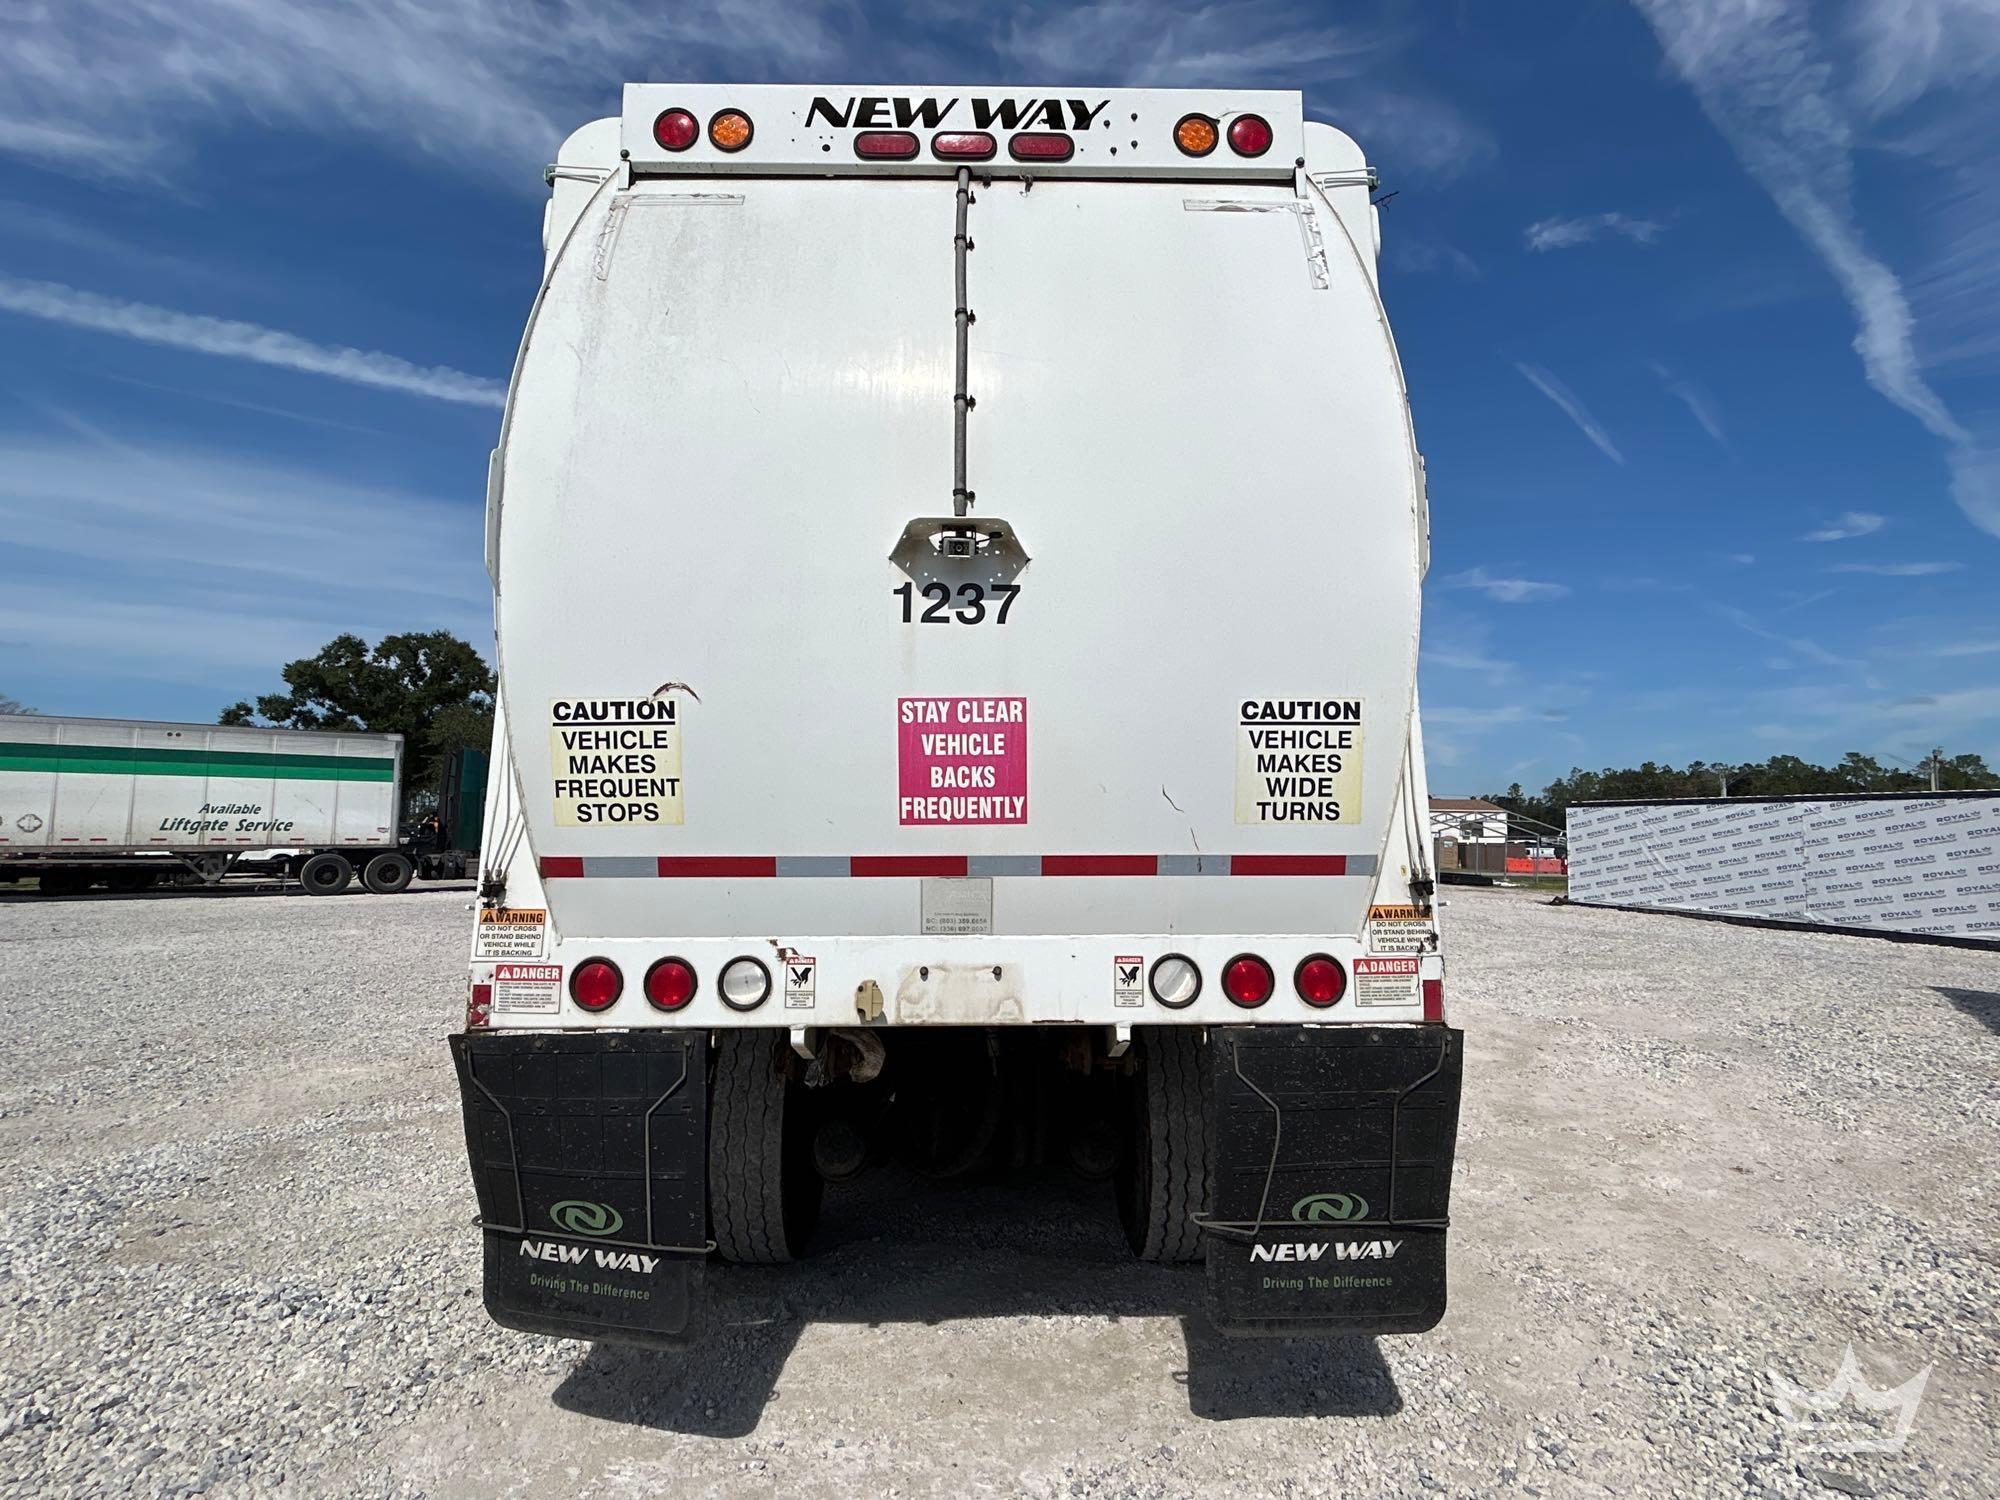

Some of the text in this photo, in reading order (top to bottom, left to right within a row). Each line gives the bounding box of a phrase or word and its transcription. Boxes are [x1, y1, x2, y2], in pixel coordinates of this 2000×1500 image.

[805, 97, 1110, 131] NEW WAY
[893, 582, 1021, 625] 1237
[552, 701, 676, 721] CAUTION
[901, 700, 1023, 723] STAY CLEAR
[1241, 701, 1361, 720] CAUTION
[561, 730, 668, 750] VEHICLE
[921, 733, 1005, 756] VEHICLE
[1248, 730, 1352, 749] VEHICLE
[569, 754, 656, 774] MAKES
[1257, 754, 1342, 773] MAKES
[930, 765, 996, 788] BACKS
[555, 778, 680, 798] FREQUENT
[1265, 777, 1333, 797] WIDE
[198, 803, 262, 815] Available
[577, 802, 659, 822] STOPS
[901, 796, 1025, 821] FREQUENTLY
[1256, 801, 1341, 821] TURNS
[1763, 803, 1787, 811] ROYAL
[1904, 801, 1937, 810] ROYAL
[1726, 811, 1749, 819] ROYAL
[1855, 811, 1881, 819] ROYAL
[1936, 813, 1970, 823] ROYAL
[159, 816, 294, 835] Liftgate Service
[1748, 821, 1773, 829] ROYAL
[1810, 820, 1837, 828] ROYAL
[1885, 823, 1914, 831] ROYAL
[1712, 829, 1736, 837] ROYAL
[1770, 832, 1795, 840] ROYAL
[1838, 831, 1866, 839] ROYAL
[1913, 835, 1946, 844] ROYAL
[1732, 840, 1756, 848] ROYAL
[1863, 844, 1893, 852] ROYAL
[1755, 851, 1780, 859] ROYAL
[1818, 851, 1844, 859] ROYAL
[1946, 848, 1981, 857] ROYAL
[1894, 856, 1926, 864] ROYAL
[1957, 885, 1991, 893] ROYAL
[495, 911, 544, 923] WARNING
[1880, 911, 1911, 919] ROYAL
[1370, 960, 1416, 973] DANGER
[512, 967, 560, 980] DANGER
[519, 1240, 660, 1274] NEW WAY
[1250, 1240, 1403, 1262] NEW WAY
[530, 1273, 650, 1300] Driving The Difference
[1263, 1275, 1393, 1290] Driving The Difference
